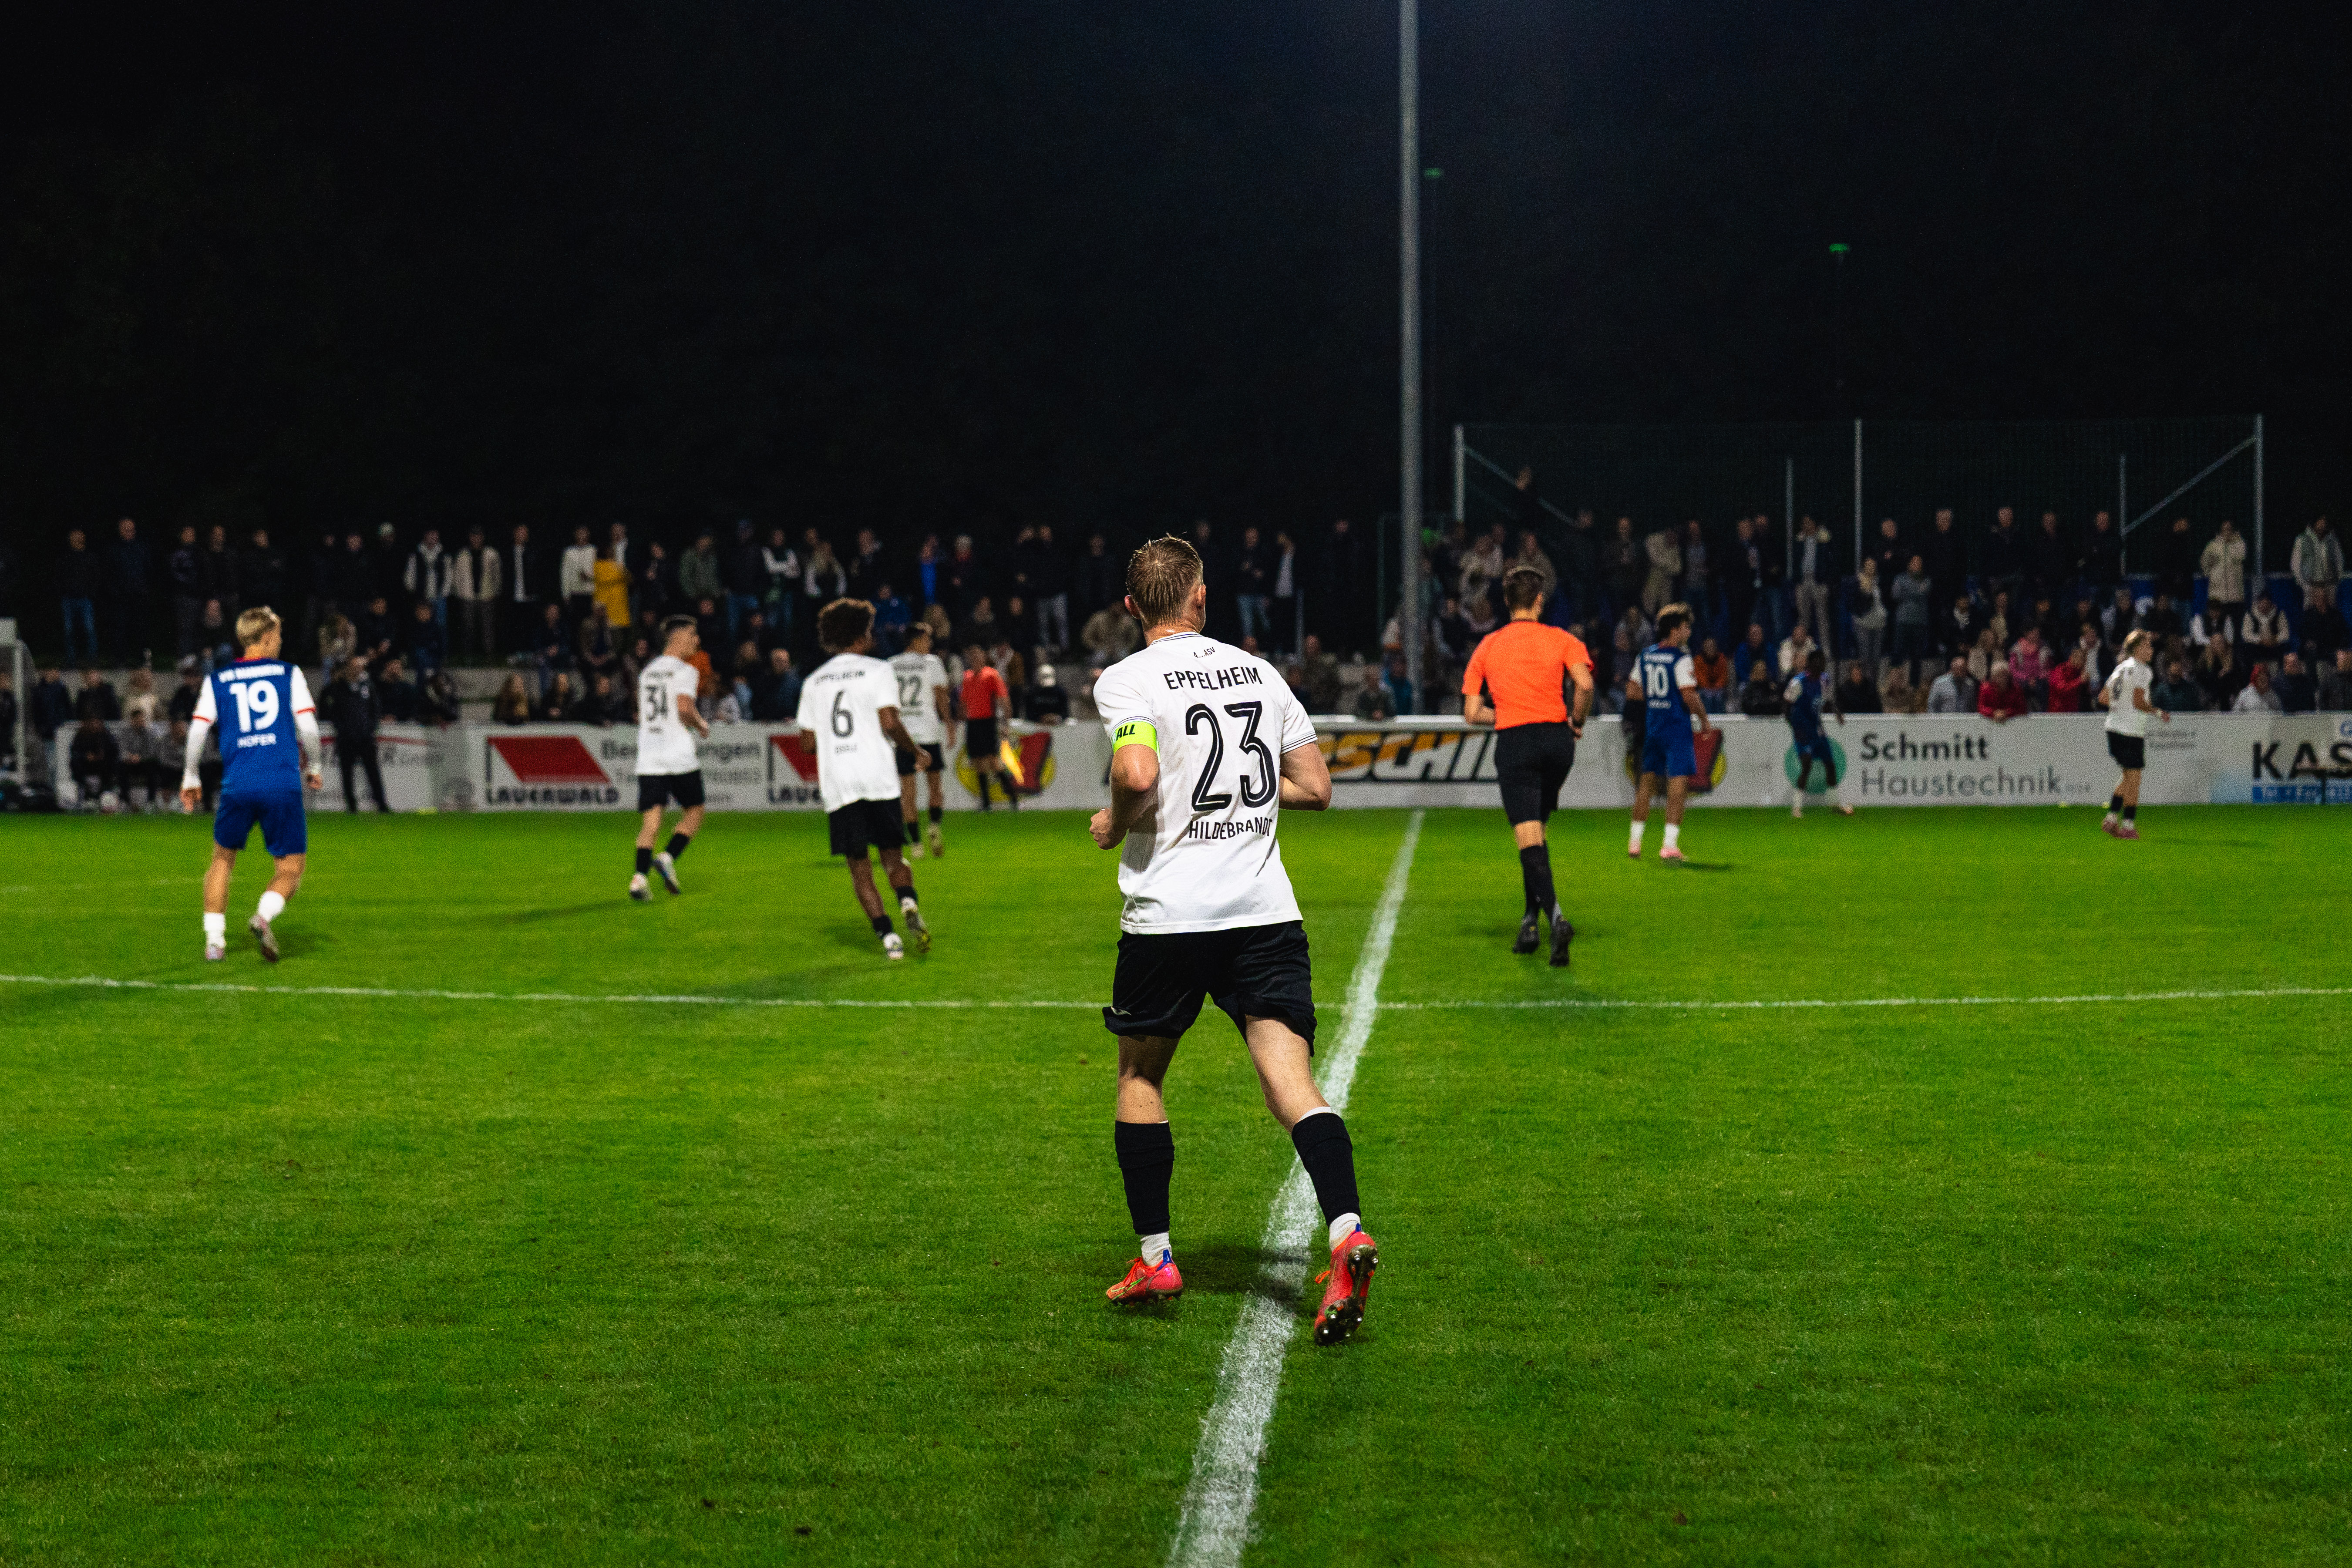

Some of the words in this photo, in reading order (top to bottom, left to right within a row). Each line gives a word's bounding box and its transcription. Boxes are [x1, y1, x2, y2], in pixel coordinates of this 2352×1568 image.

[1164, 666, 1262, 690] EPPELHEIM
[1644, 663, 1669, 698] 10
[229, 680, 279, 733] 19
[831, 688, 854, 738] 6
[1185, 701, 1276, 811] 23
[1861, 732, 1991, 760] Schmitt
[1862, 765, 2061, 796] Haustechnik
[1188, 817, 1273, 840] HILDEBRANDT
